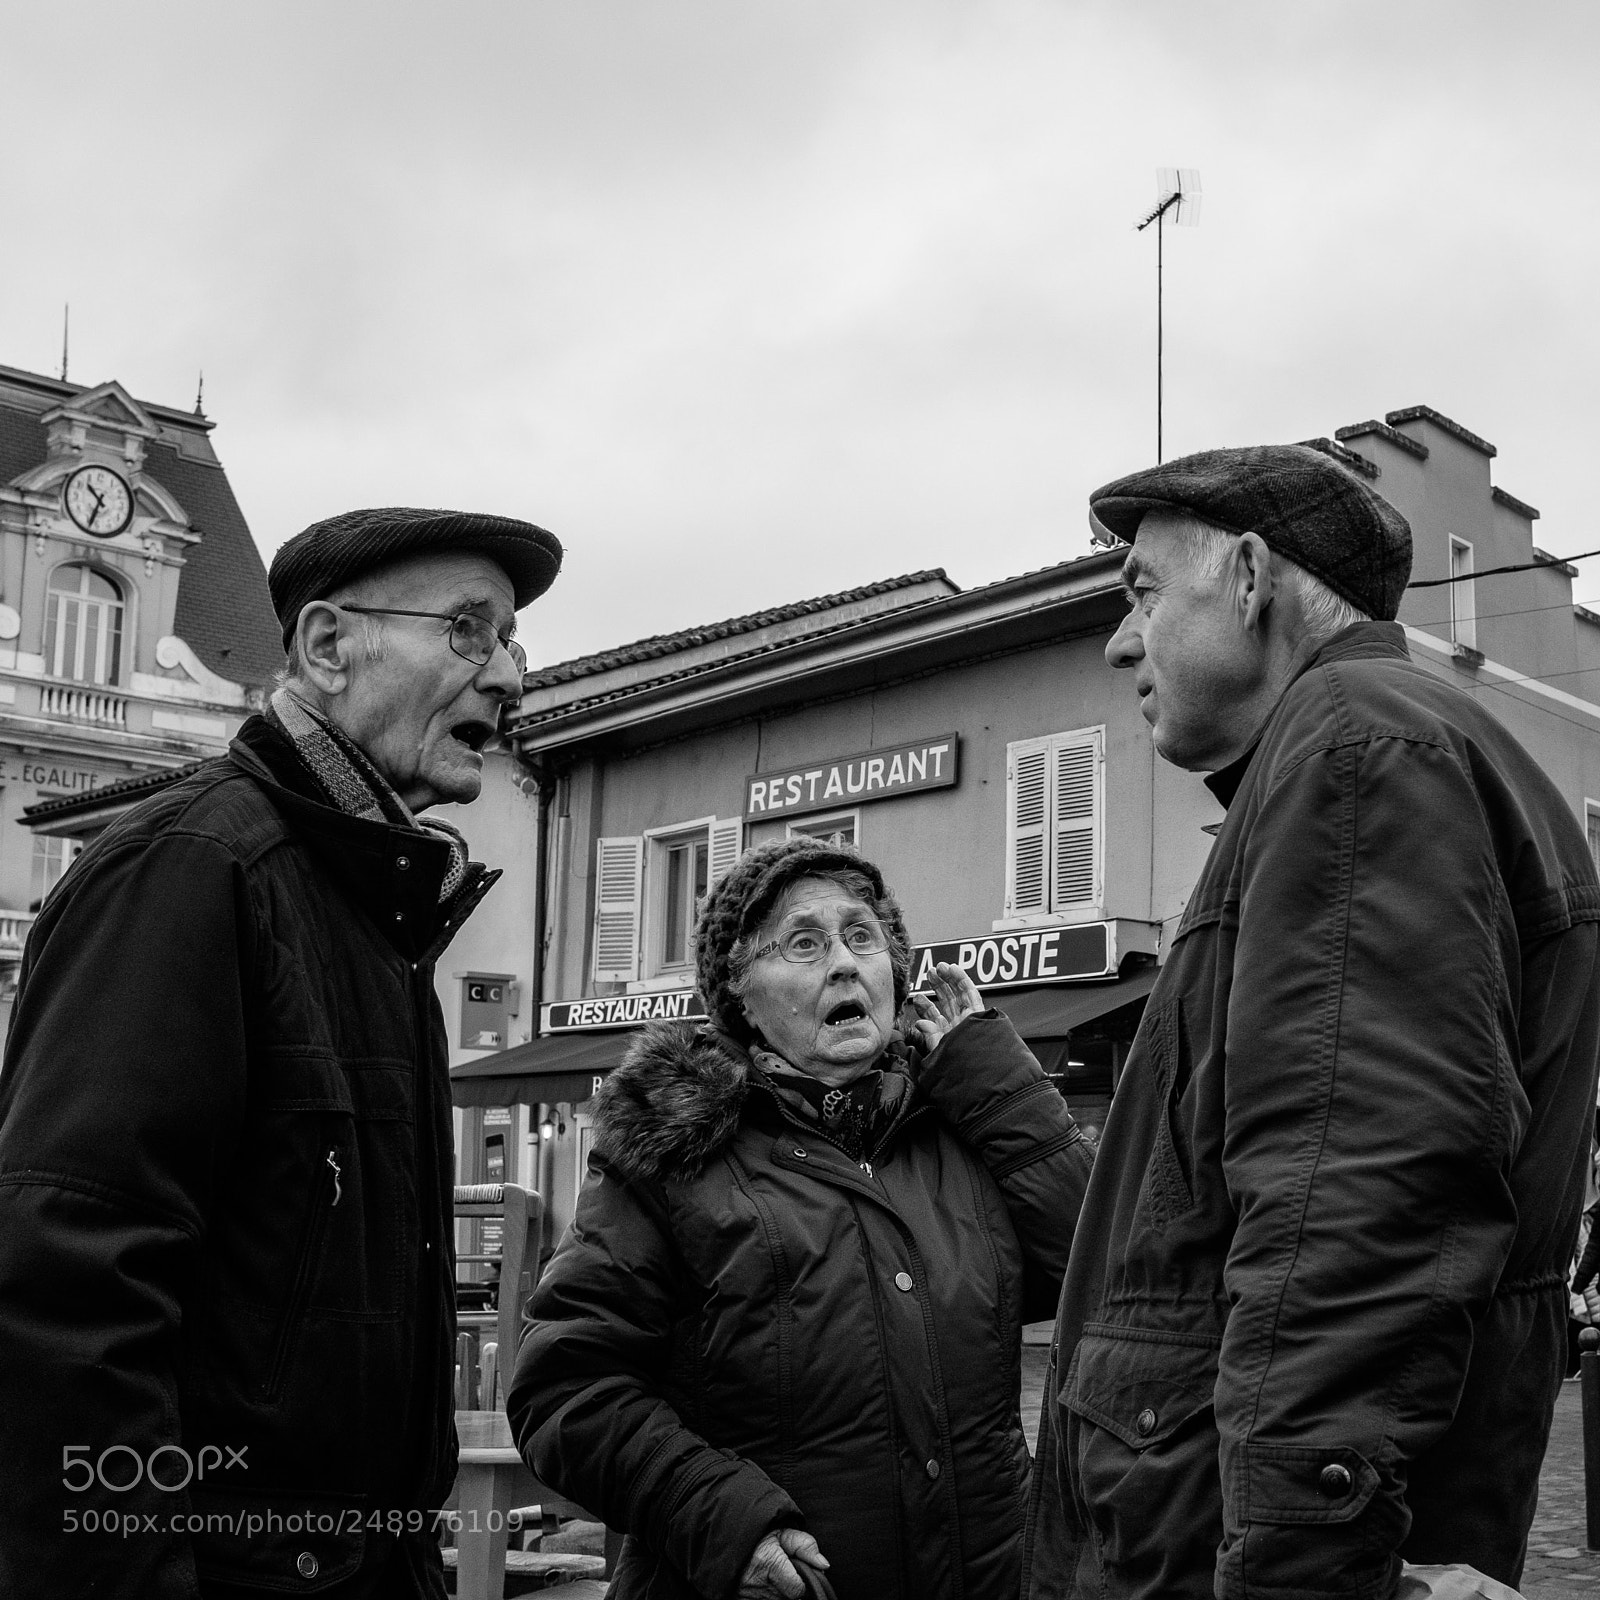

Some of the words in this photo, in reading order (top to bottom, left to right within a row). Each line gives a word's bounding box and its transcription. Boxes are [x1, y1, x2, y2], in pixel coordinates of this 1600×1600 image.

[749, 744, 949, 813] RESTAURANT
[958, 932, 1061, 983] POSTE
[567, 993, 694, 1026] RESTAURANT
